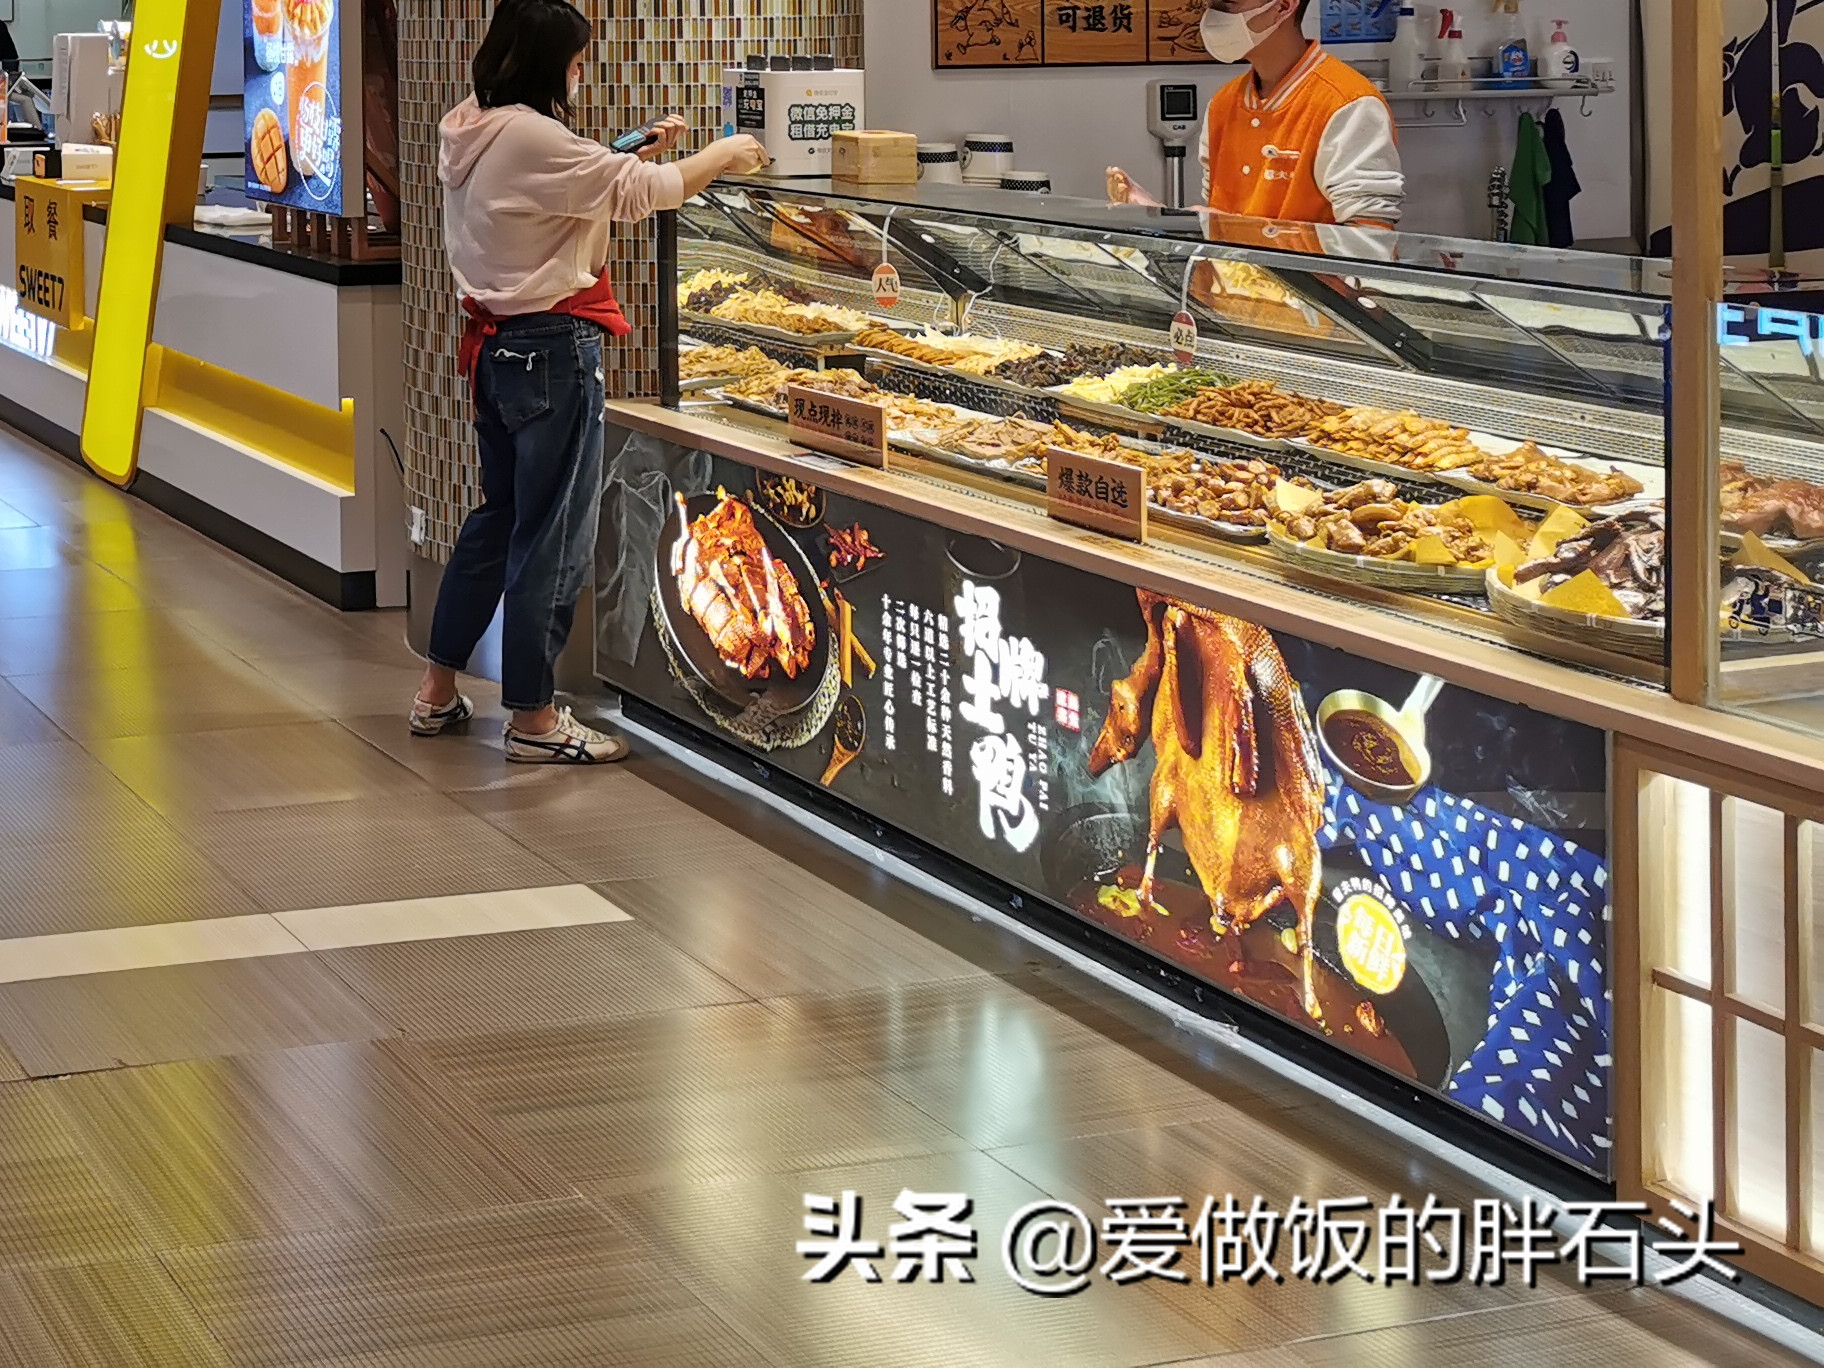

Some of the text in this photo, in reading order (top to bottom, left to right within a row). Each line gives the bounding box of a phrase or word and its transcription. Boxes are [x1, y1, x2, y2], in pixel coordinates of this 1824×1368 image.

[1054, 4, 1134, 33] 可退货
[788, 103, 856, 122] 微信免押金
[23, 194, 59, 241] 取餐
[18, 264, 65, 313] SWEET7
[875, 275, 898, 292] 人气
[1173, 325, 1194, 347] 必点
[793, 397, 844, 431] 现点现拌
[1057, 465, 1129, 509] 爆款自选
[954, 579, 1046, 853] 招牌土鸭
[1027, 721, 1038, 772] TU YA
[1037, 723, 1050, 811] ZHAO PAI
